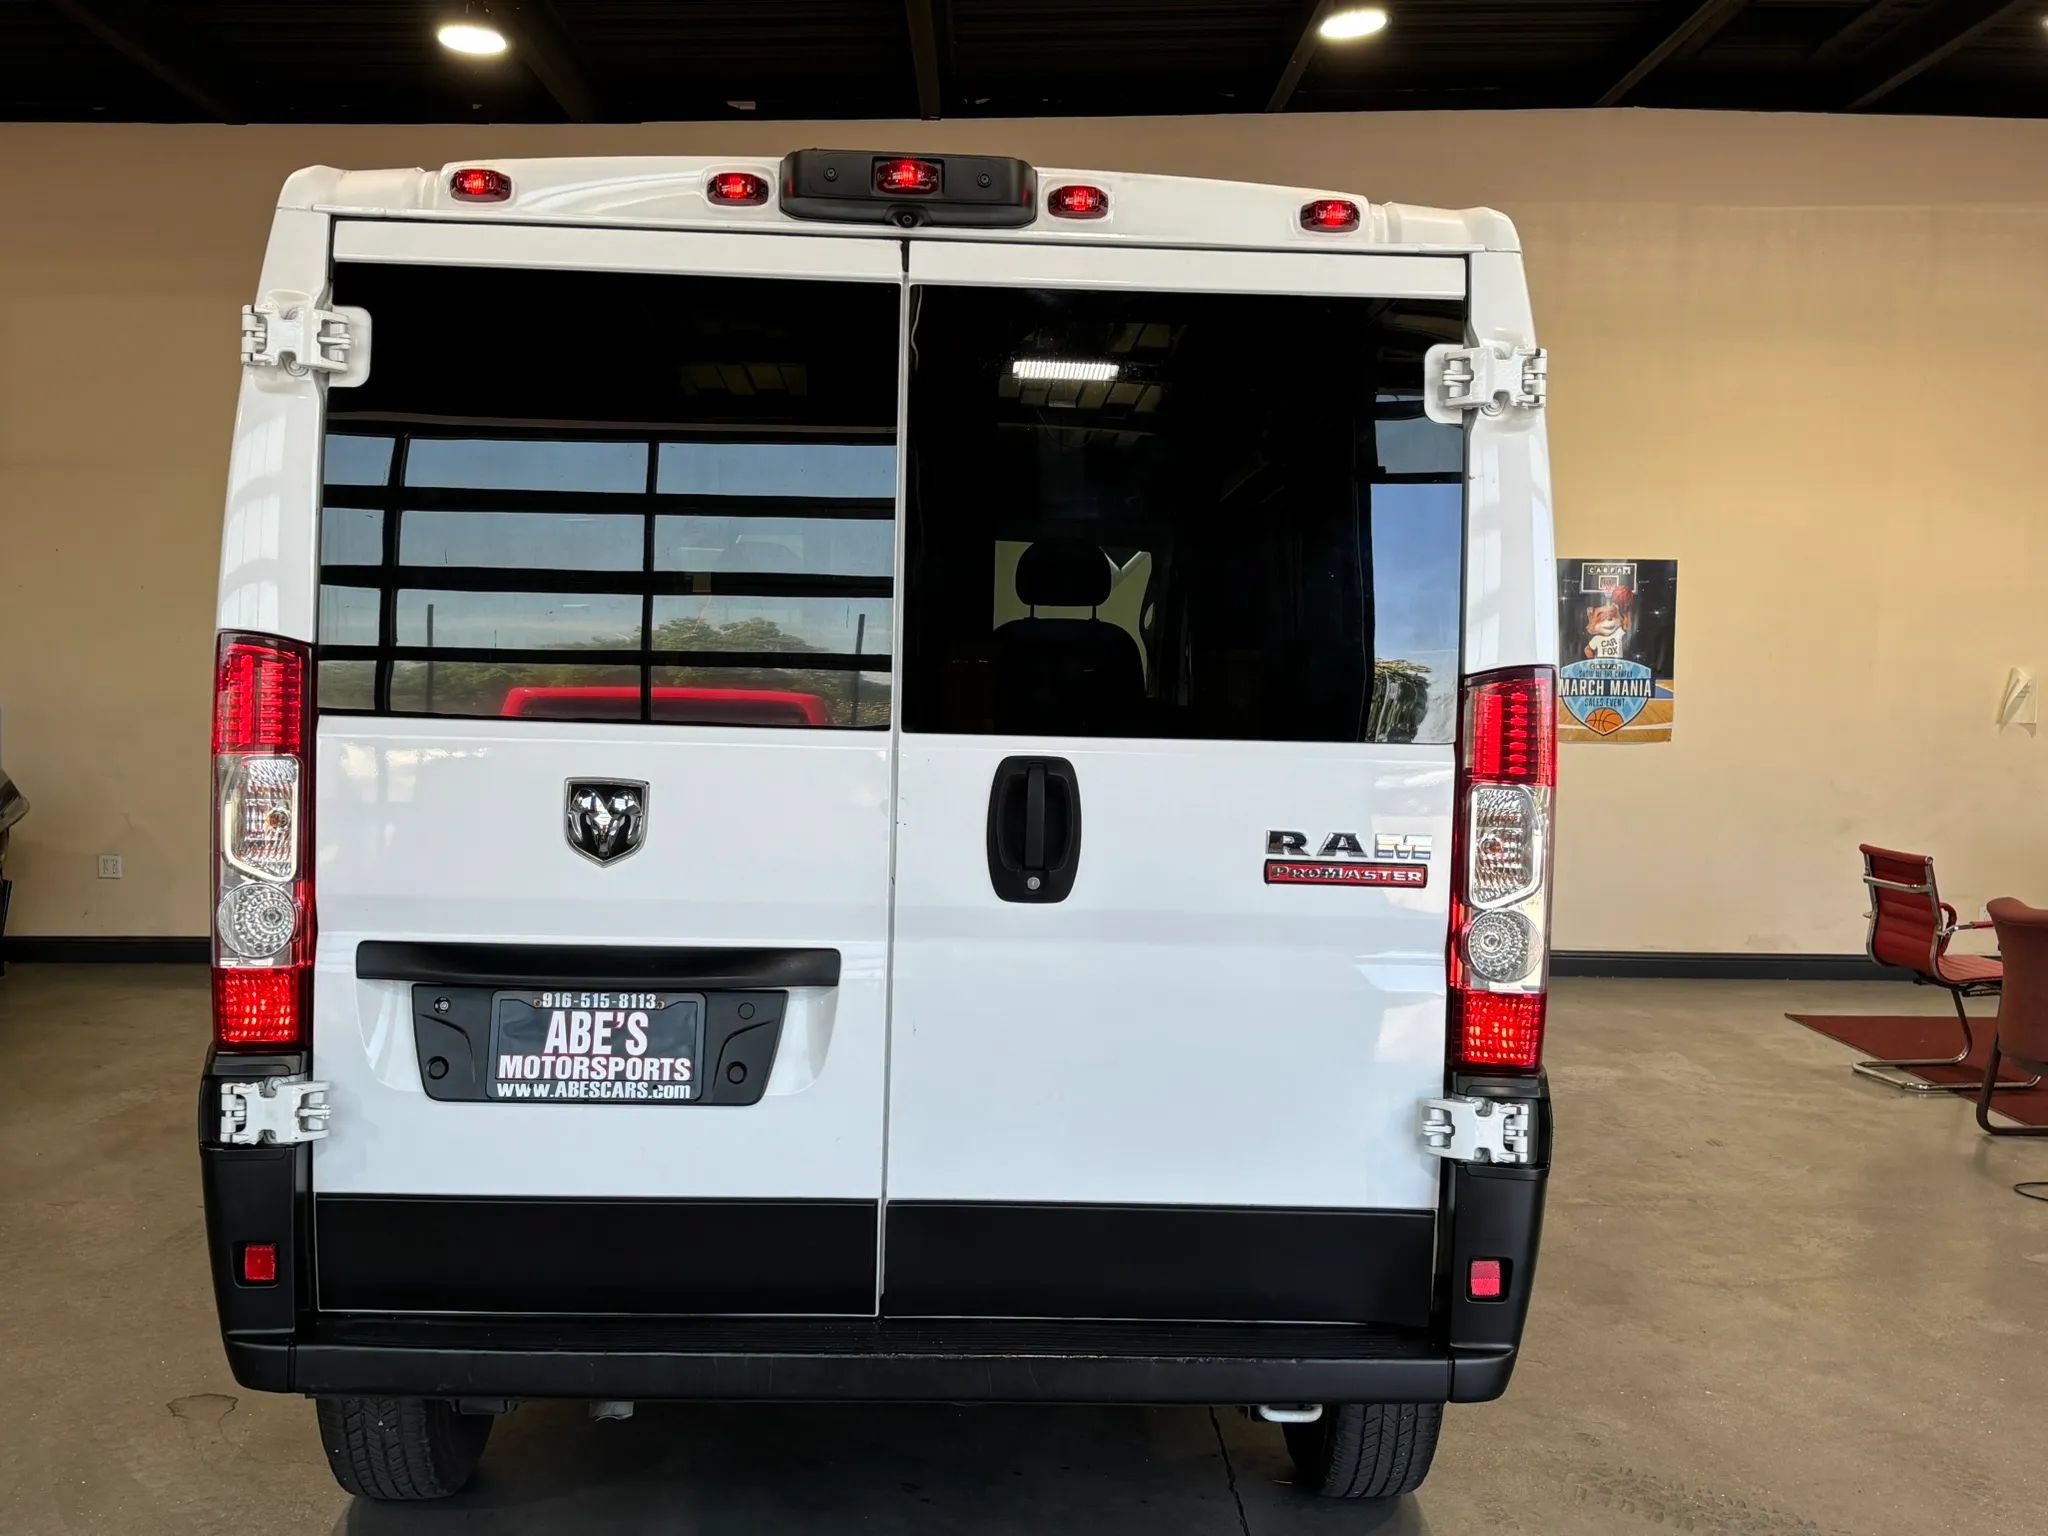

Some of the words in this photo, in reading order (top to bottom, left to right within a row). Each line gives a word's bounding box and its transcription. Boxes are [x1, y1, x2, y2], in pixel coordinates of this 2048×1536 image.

[1601, 638, 1618, 648] CAR
[1602, 647, 1618, 656] FOX
[1559, 679, 1604, 696] MARCH
[1610, 679, 1652, 697] MANIA
[1584, 698, 1604, 707] SALES
[1606, 698, 1625, 708] EVENT
[1265, 829, 1433, 860] RAM
[542, 992, 656, 1009] 916-515-8113
[544, 1010, 649, 1056] ABE'S
[498, 1055, 692, 1082] MOTORSPORTS
[496, 1081, 691, 1100] www.ABESCARS.com
